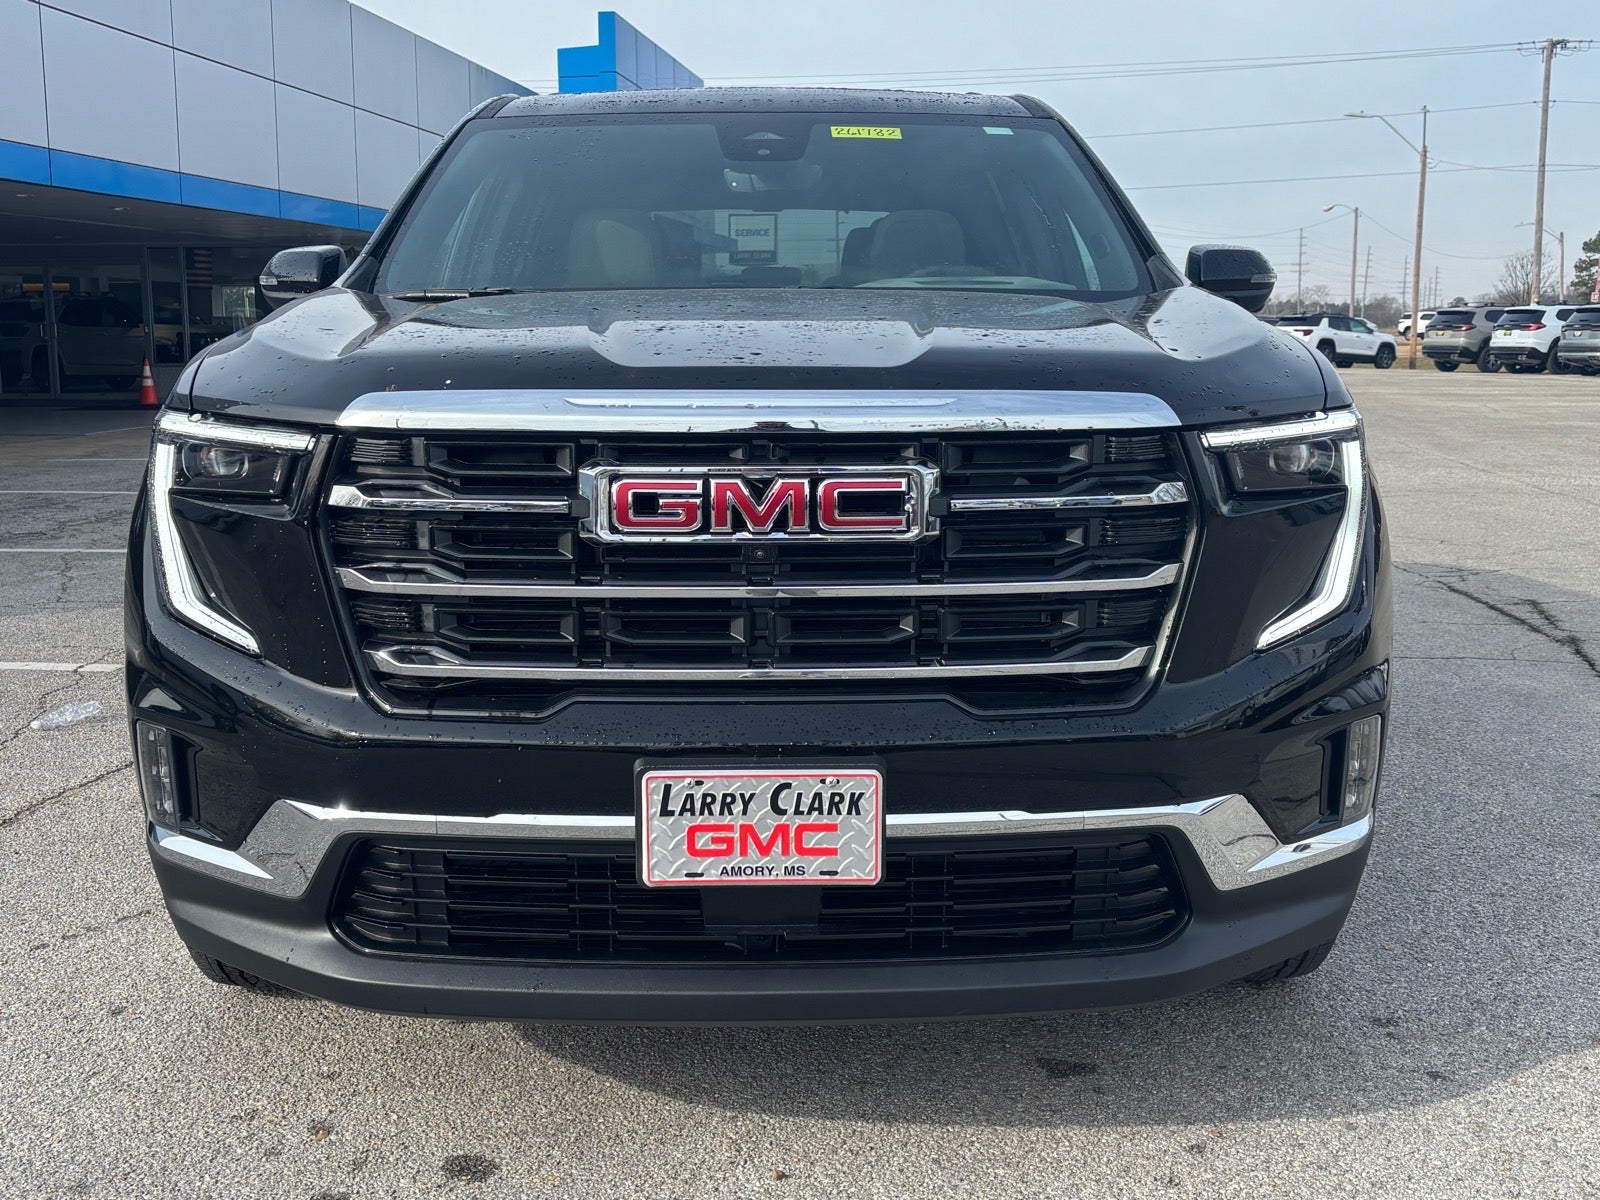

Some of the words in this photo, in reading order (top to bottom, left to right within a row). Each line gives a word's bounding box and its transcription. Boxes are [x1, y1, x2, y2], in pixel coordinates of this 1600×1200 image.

[735, 228, 770, 237] SERVICE
[612, 478, 910, 533] GMC
[659, 783, 756, 817] LARRY
[770, 782, 865, 816] CLARK
[686, 823, 839, 858] GMC
[719, 866, 778, 878] AMORY,
[784, 866, 806, 877] MS
